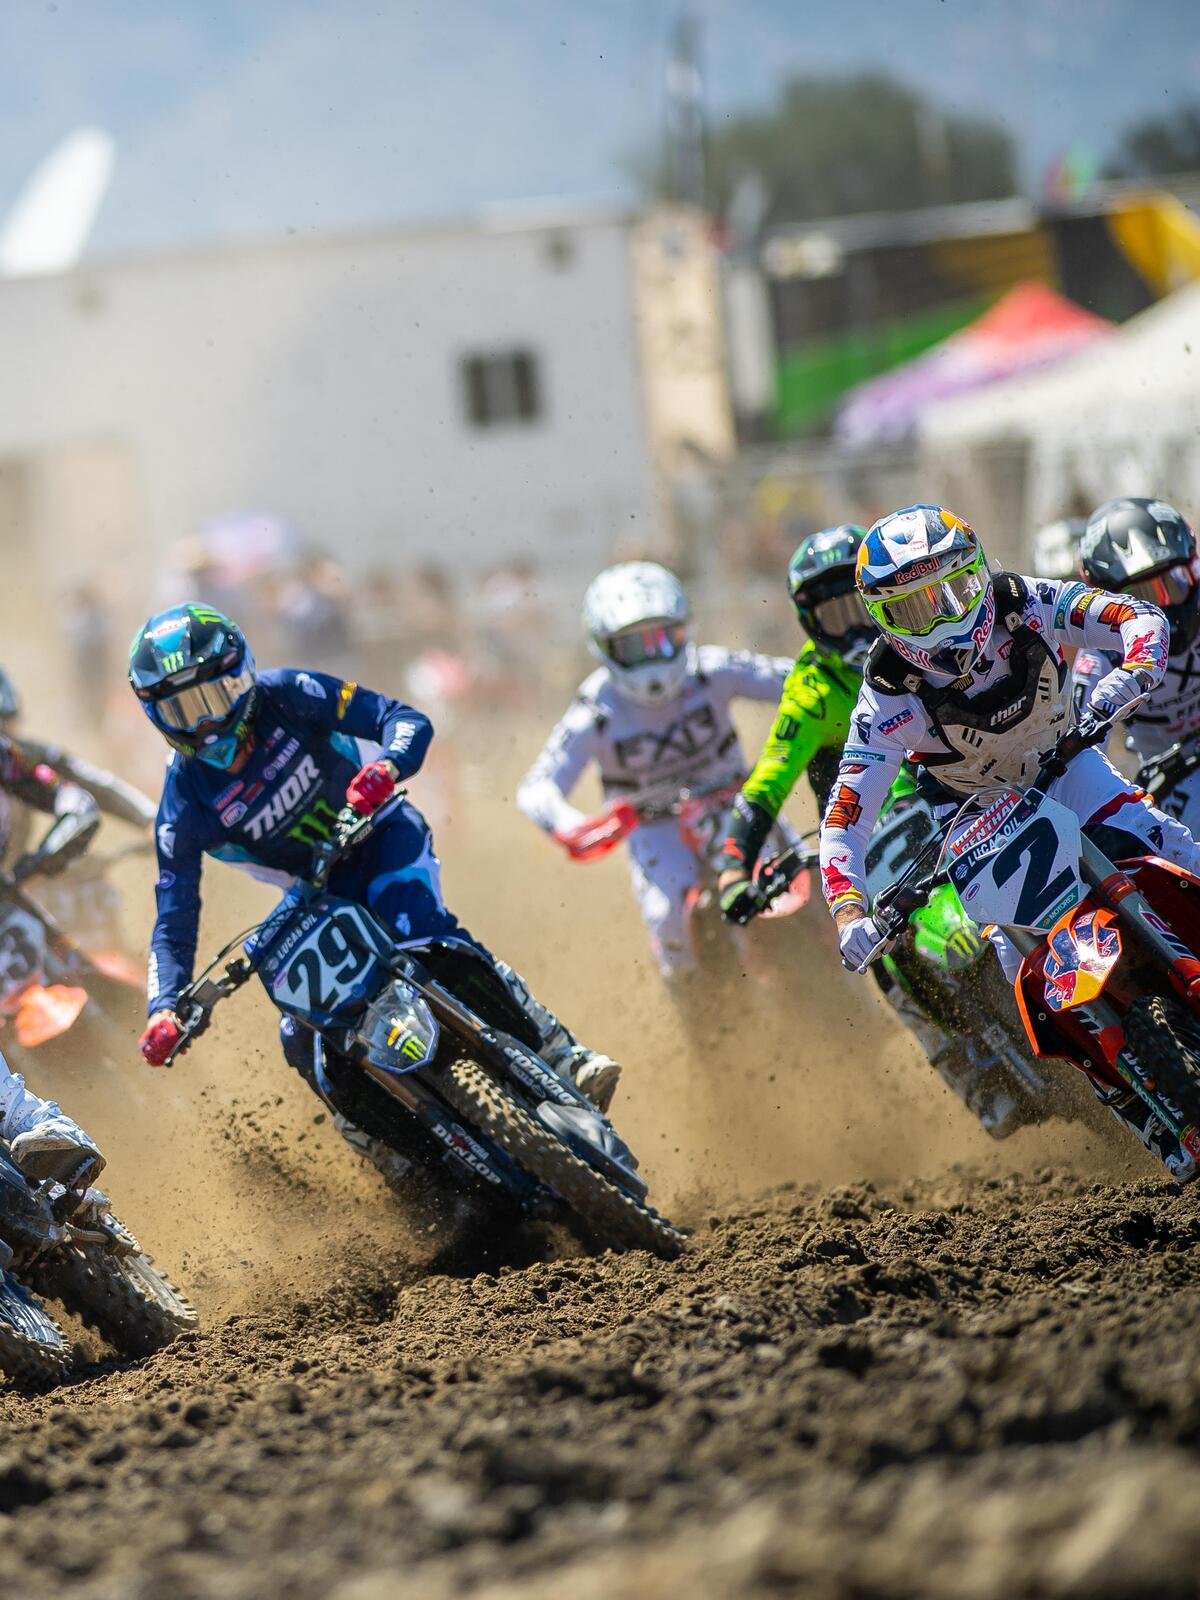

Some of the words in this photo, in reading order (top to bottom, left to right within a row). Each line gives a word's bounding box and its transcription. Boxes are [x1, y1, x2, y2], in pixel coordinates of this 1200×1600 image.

[894, 564, 918, 585] Red
[918, 556, 941, 577] Bull
[873, 675, 898, 690] thor
[990, 696, 1027, 727] thor
[243, 753, 321, 841] THOR
[954, 791, 1012, 846] RENTHAL
[961, 799, 1016, 853] RENTHAL
[1003, 816, 1021, 838] OIL
[992, 816, 1077, 924] 2
[302, 913, 318, 931] OIL
[1048, 892, 1077, 920] MOTOREX
[288, 912, 371, 1014] 29
[503, 1046, 579, 1106] DUNLOP
[431, 1122, 502, 1184] DUNLOP
